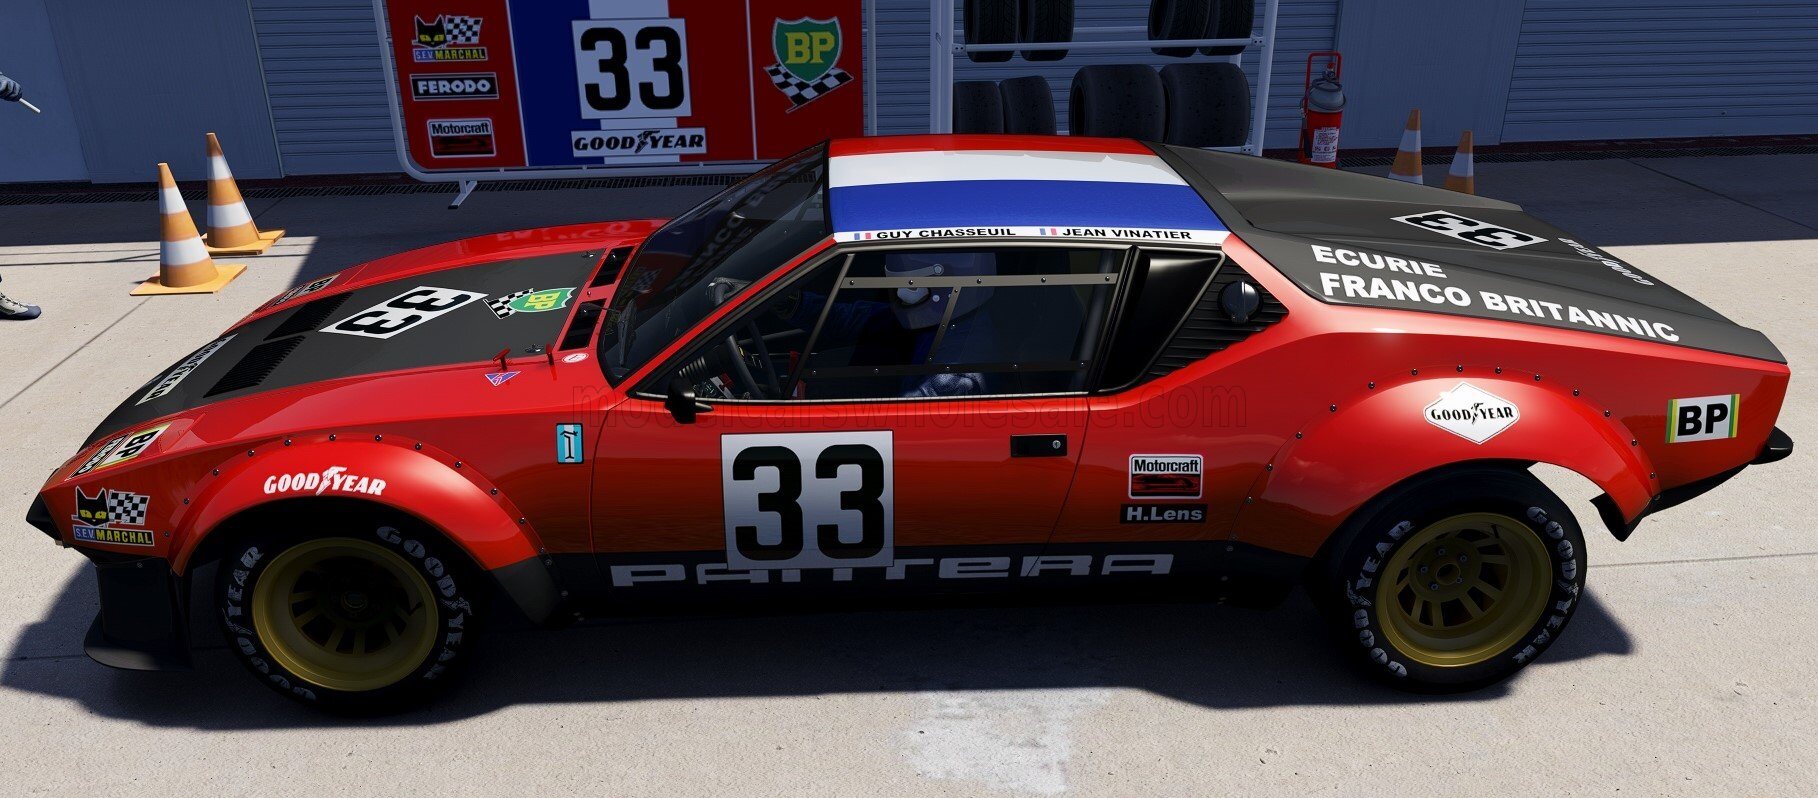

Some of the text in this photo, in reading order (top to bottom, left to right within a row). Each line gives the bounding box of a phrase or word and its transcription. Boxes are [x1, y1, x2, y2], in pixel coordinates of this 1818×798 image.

[435, 49, 486, 60] MARCHAL
[785, 31, 836, 64] BP
[581, 27, 684, 111] 33
[417, 79, 491, 94] FERODO
[432, 122, 489, 135] Motorcraft
[876, 228, 1016, 239] GUY CHASSEUIL
[1063, 228, 1192, 240] JEAN VINATIER
[1404, 213, 1534, 247] 33
[1311, 244, 1447, 278] ECURIE
[335, 289, 471, 335] 33
[525, 291, 561, 310] BP
[1320, 272, 1680, 342] FRANCO BRITANNIC
[1677, 403, 1728, 436] BP
[115, 429, 160, 458] BP
[1134, 459, 1199, 472] Motorcraft
[733, 444, 884, 561] 33
[1126, 506, 1203, 521] H.Lens
[95, 529, 152, 544] MARCHAL
